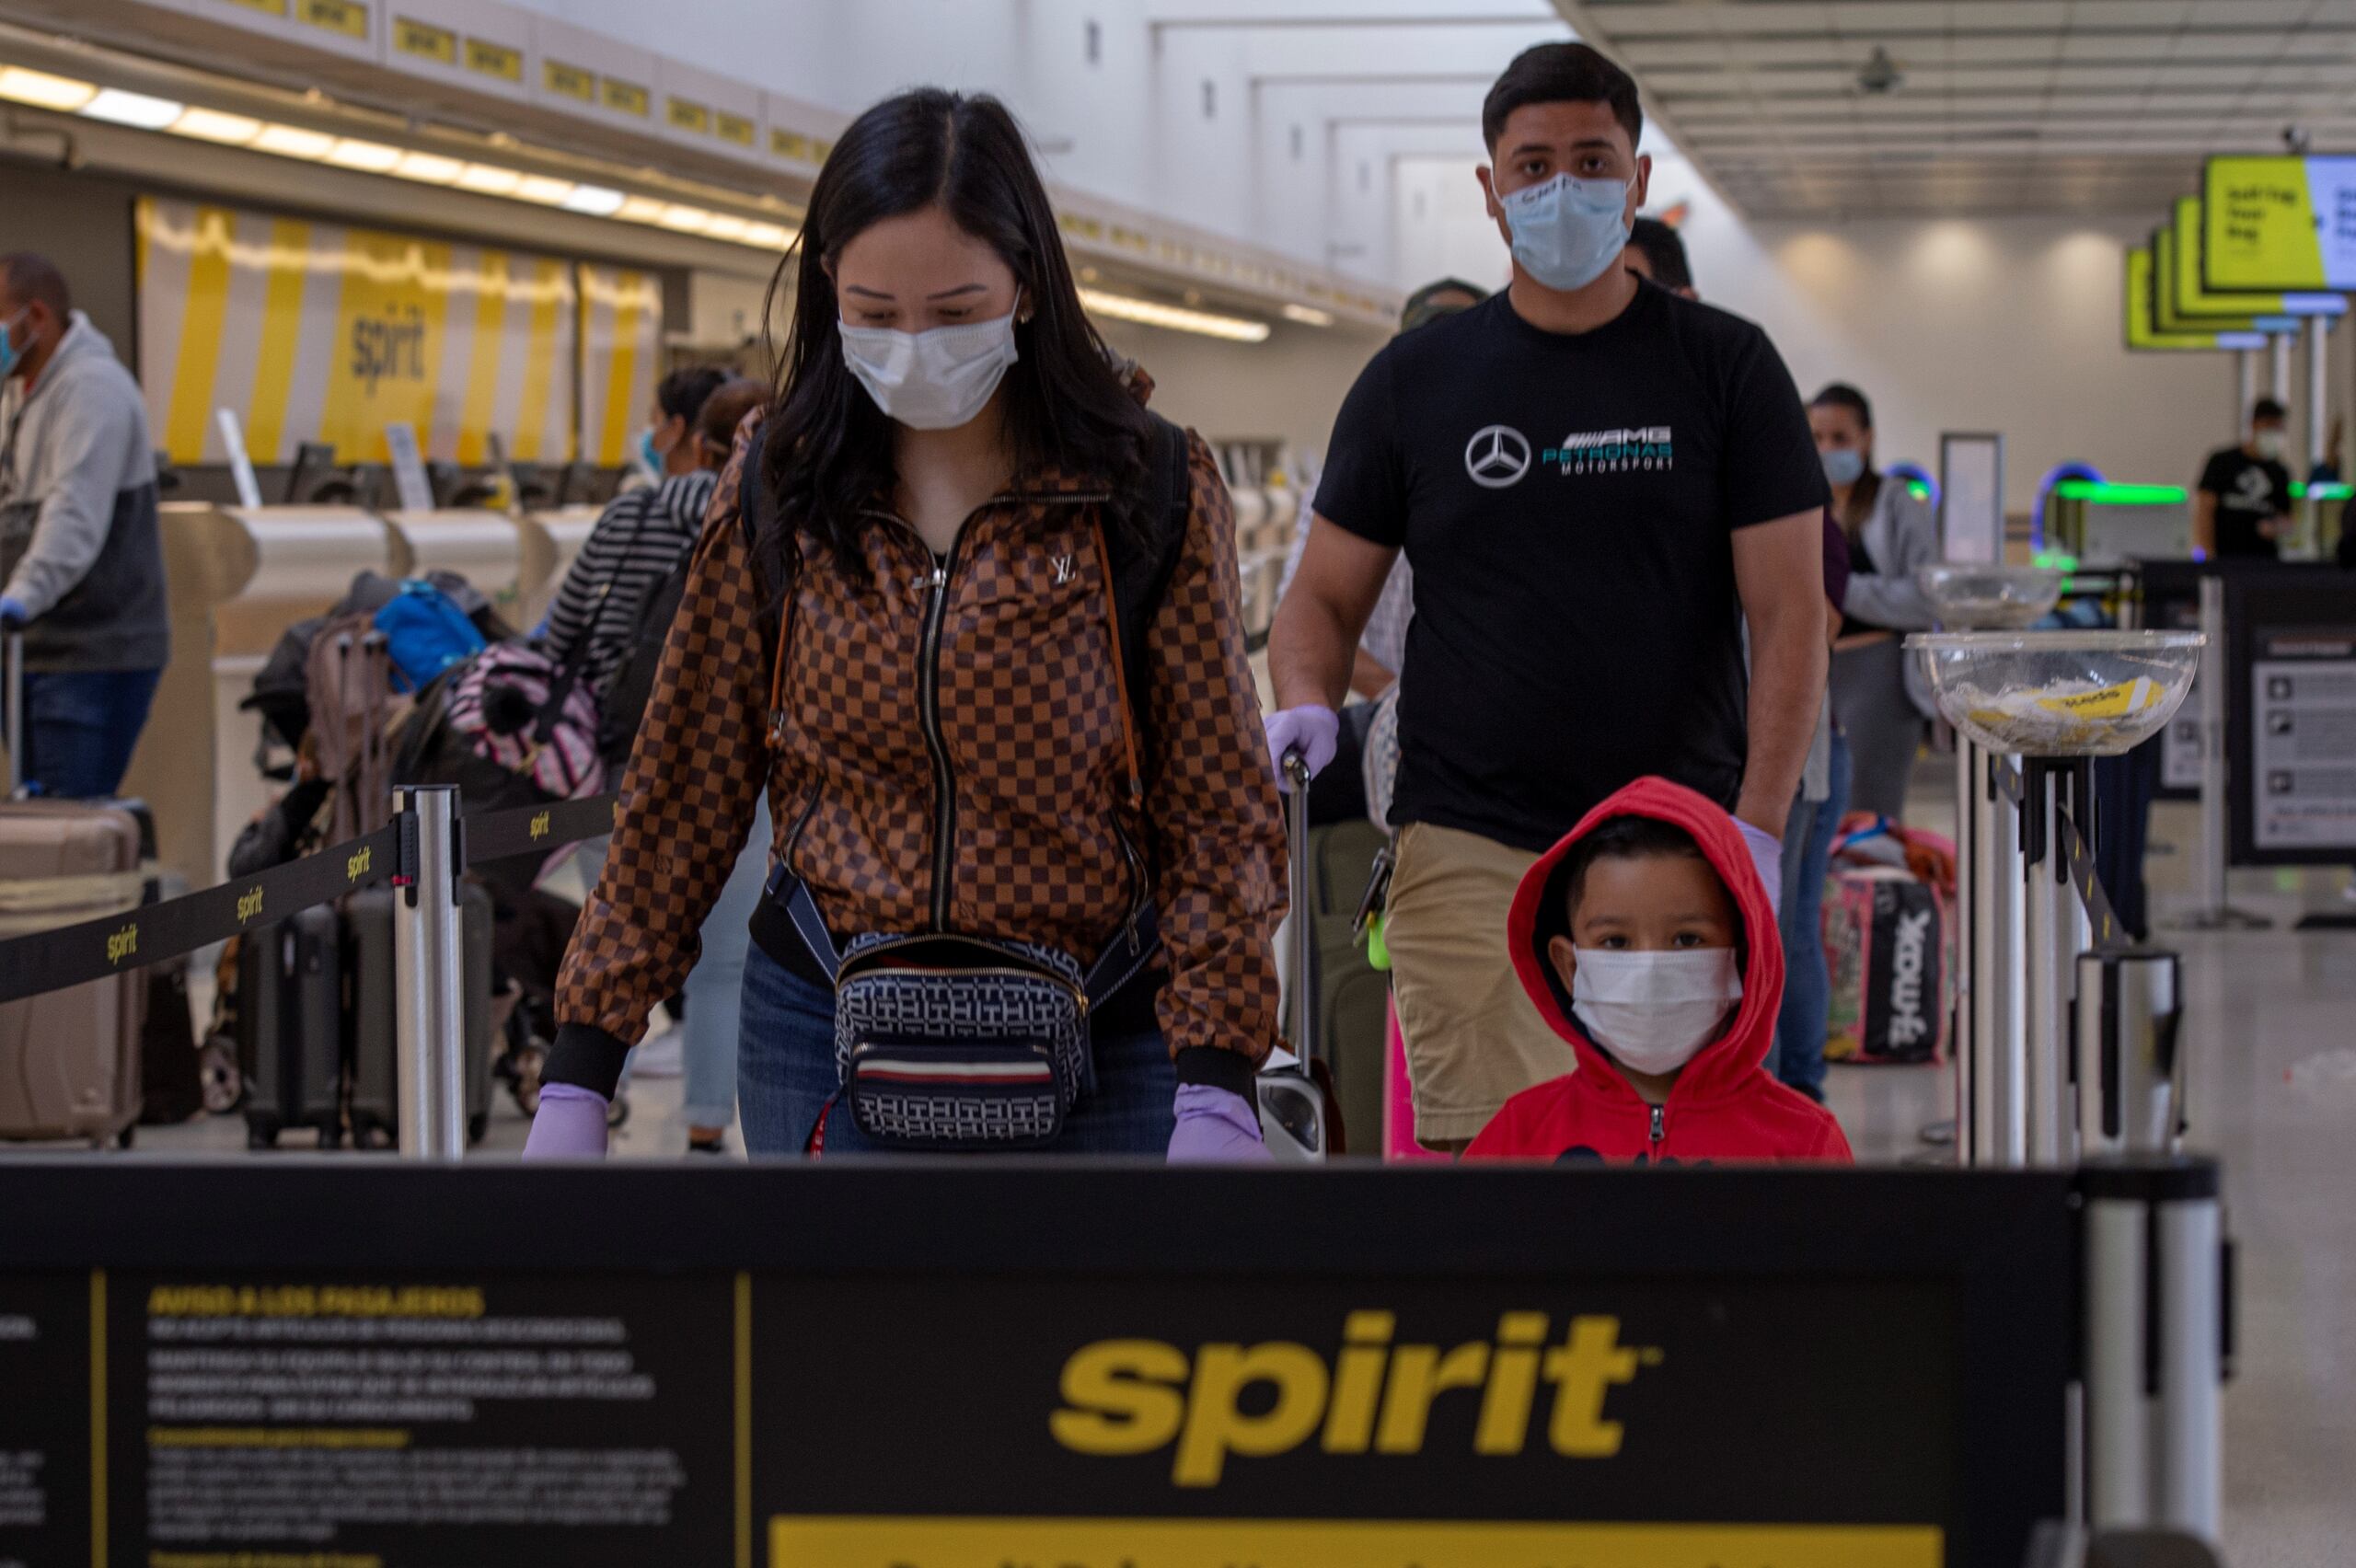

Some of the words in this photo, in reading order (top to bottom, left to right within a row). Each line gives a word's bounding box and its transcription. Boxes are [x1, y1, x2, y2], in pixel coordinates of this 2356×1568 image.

[352, 301, 425, 398] spirit
[1542, 443, 1672, 465] PETRONAS
[1562, 456, 1673, 476] MOTORSPORT
[530, 810, 549, 842] spirit
[347, 845, 371, 881] spirit
[237, 885, 263, 925] spirit
[108, 923, 137, 964] spirit
[1049, 1310, 1640, 1488] spirit
